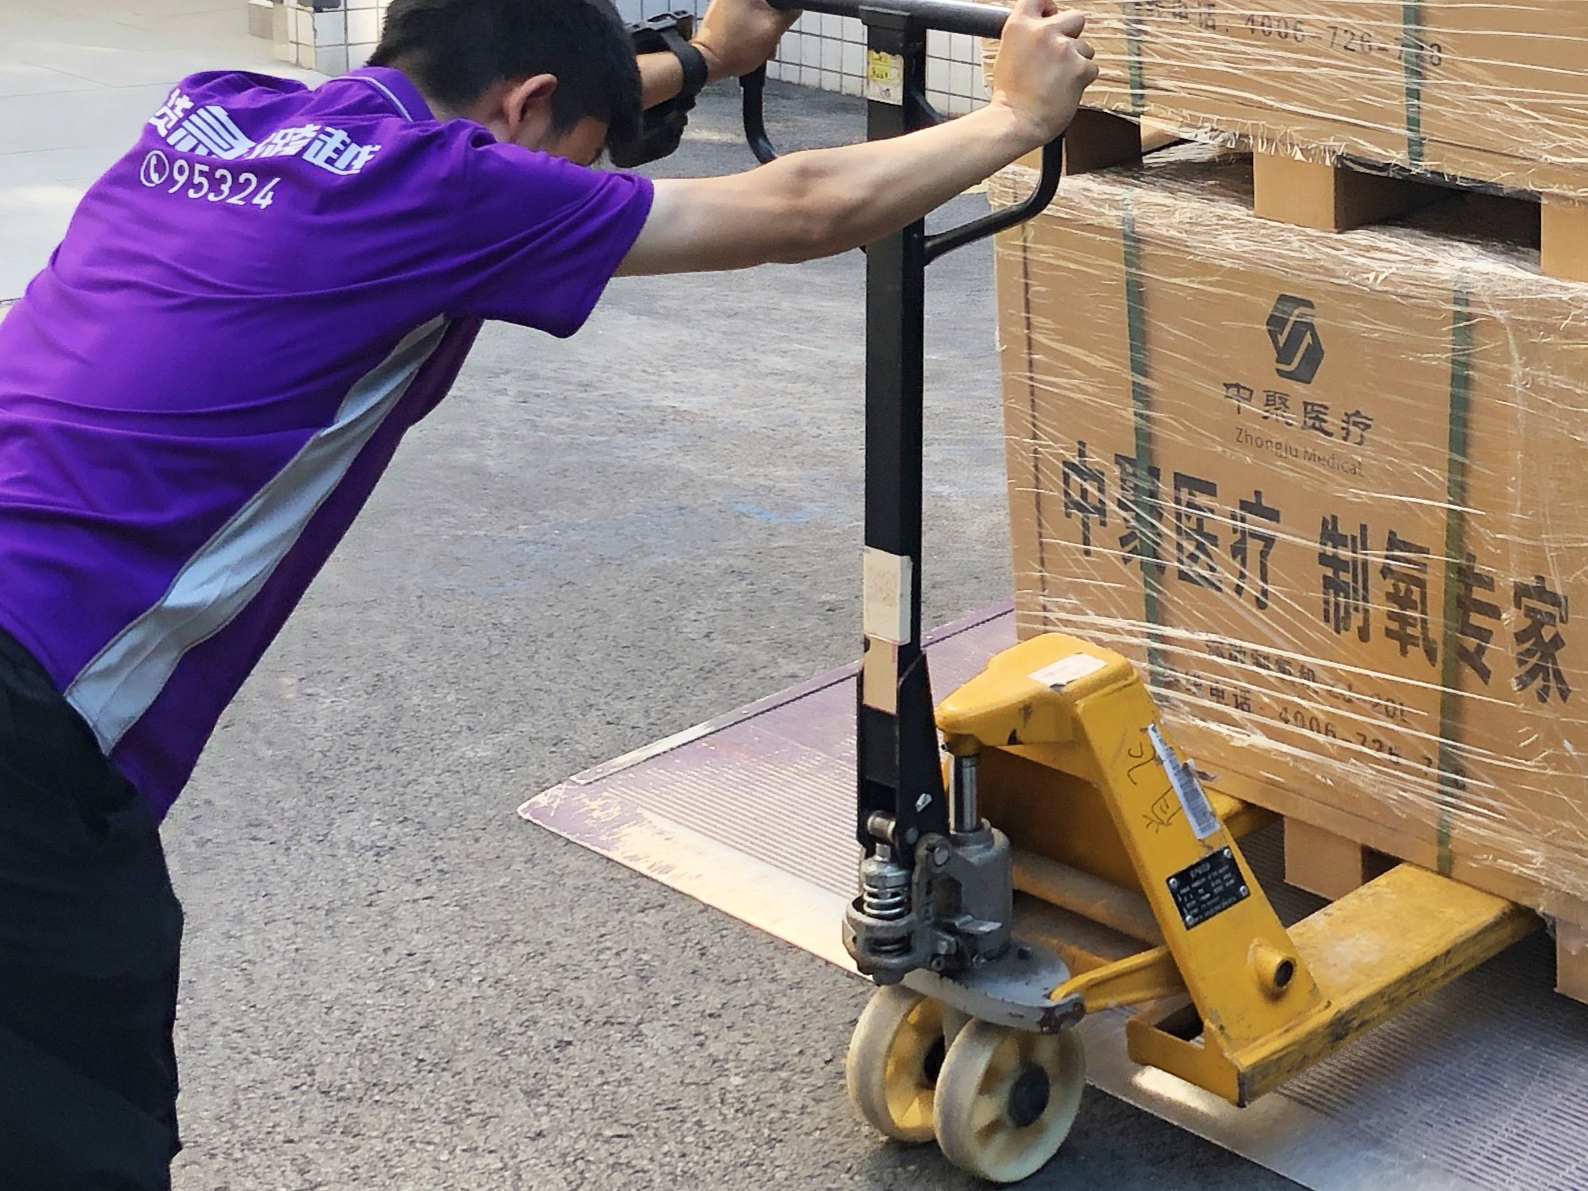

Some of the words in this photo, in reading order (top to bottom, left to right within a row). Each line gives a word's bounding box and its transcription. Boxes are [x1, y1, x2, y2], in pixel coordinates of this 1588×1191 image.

[168, 159, 281, 210] 95324
[1222, 382, 1374, 447] 中聚医疗
[1235, 427, 1299, 459] Zhongju
[1302, 447, 1364, 478] Medical
[1061, 439, 1282, 612] 中聚医疗
[1317, 513, 1573, 705] 制氧专家
